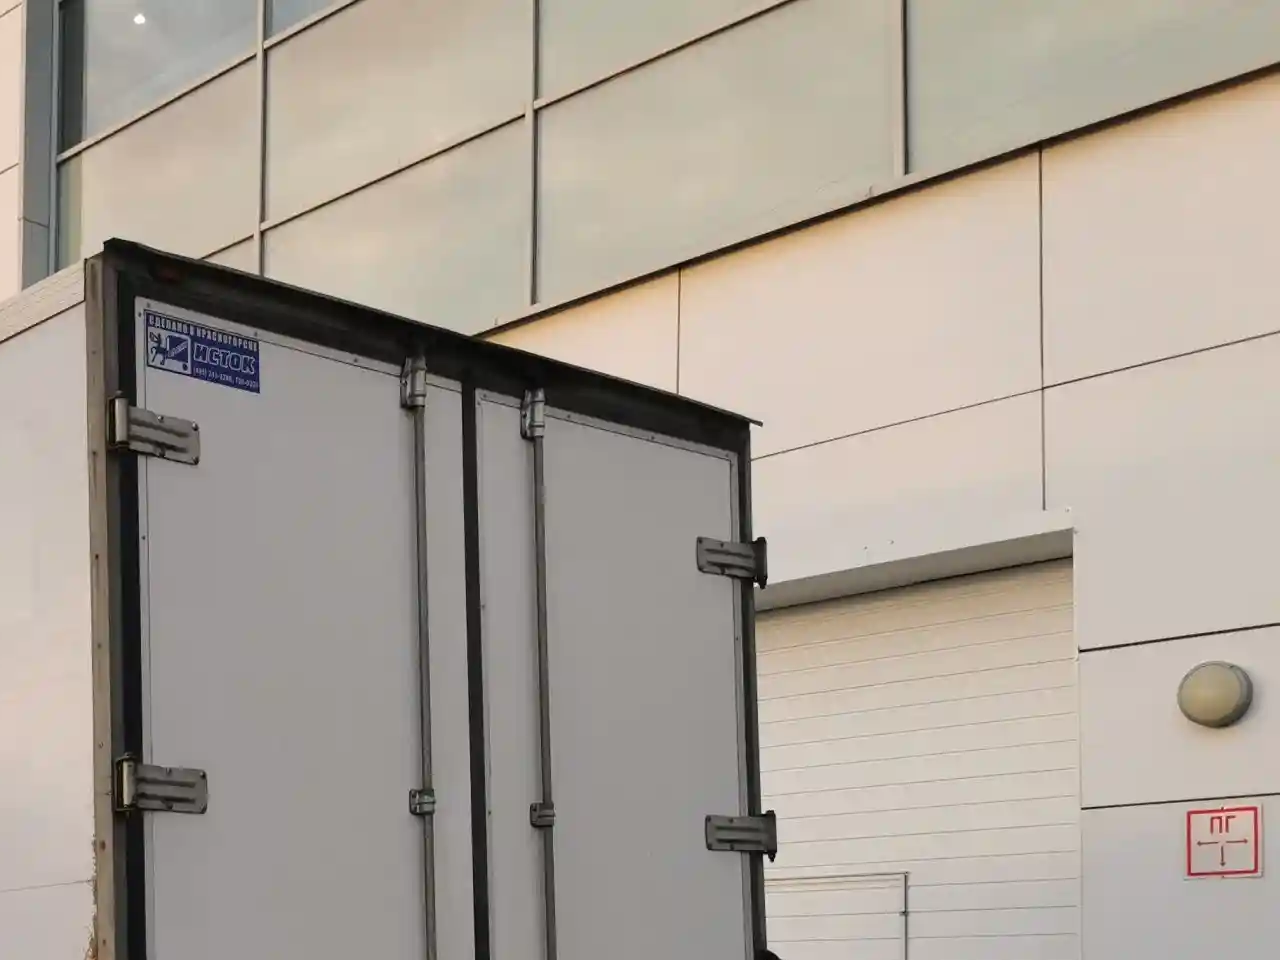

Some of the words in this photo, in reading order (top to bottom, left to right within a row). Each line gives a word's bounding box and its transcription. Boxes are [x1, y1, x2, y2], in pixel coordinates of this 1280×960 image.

[148, 314, 187, 335] СДЕЛАНО
[193, 342, 256, 375] ИСТОК
[1210, 815, 1236, 834] ПГ
